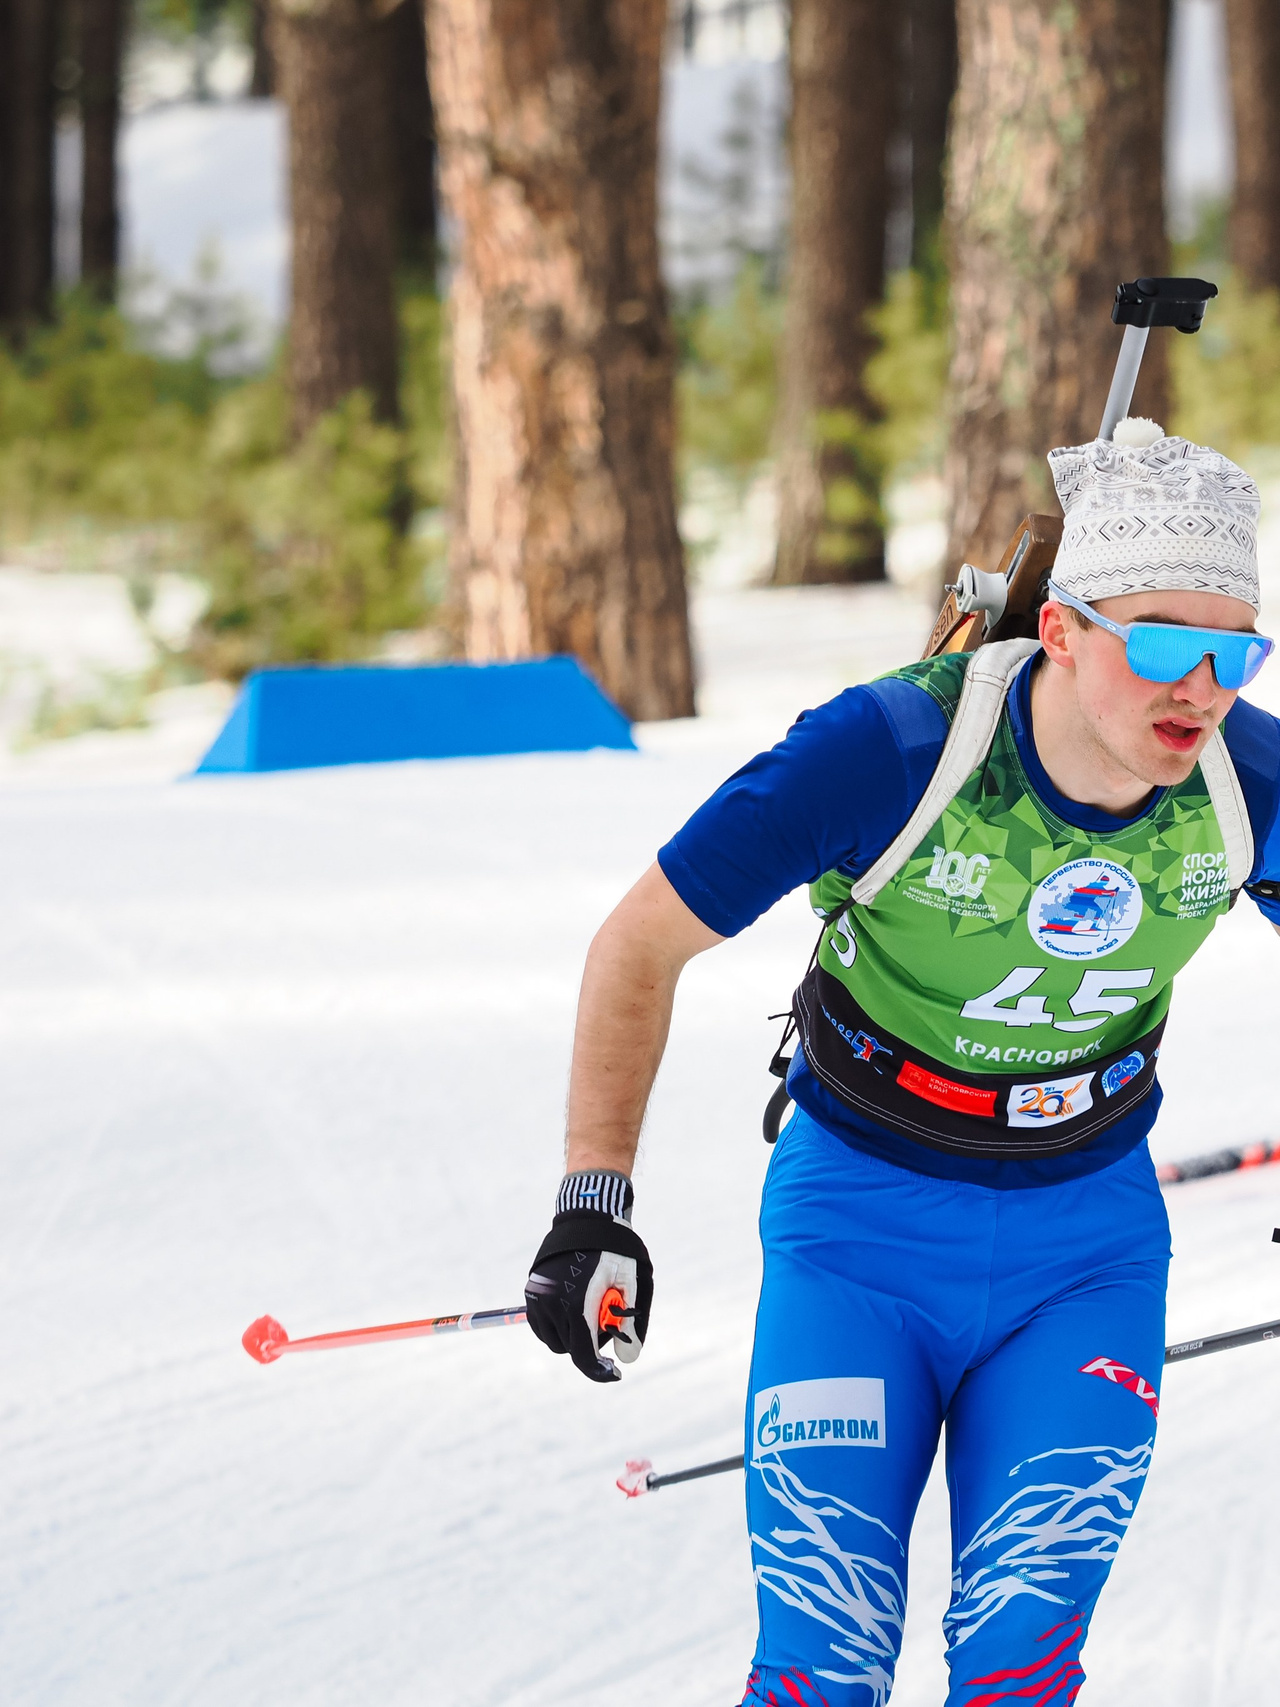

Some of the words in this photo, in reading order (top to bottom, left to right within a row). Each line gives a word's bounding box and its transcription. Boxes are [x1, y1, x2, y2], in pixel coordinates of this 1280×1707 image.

[1042, 860, 1102, 889] ПЕРВЕНСТВО
[1104, 863, 1136, 889] РОССИИ
[1181, 867, 1230, 887] НОРМ
[902, 890, 950, 912] РОССИЙСКОЙ
[950, 906, 999, 919] ФЕДЕРАЦИИ
[908, 886, 966, 909] МИНИСТЕРСТВО
[967, 902, 997, 912] СПОРТА
[1176, 909, 1207, 920] ПРОЕКТ
[1044, 940, 1092, 956] Красноярск
[1096, 938, 1119, 953] 2023
[959, 966, 1155, 1033] 45
[955, 1035, 1105, 1066] КРАСНОЯРСК
[928, 1083, 949, 1095] КРАЙ
[782, 1418, 879, 1443] GAZPROM
